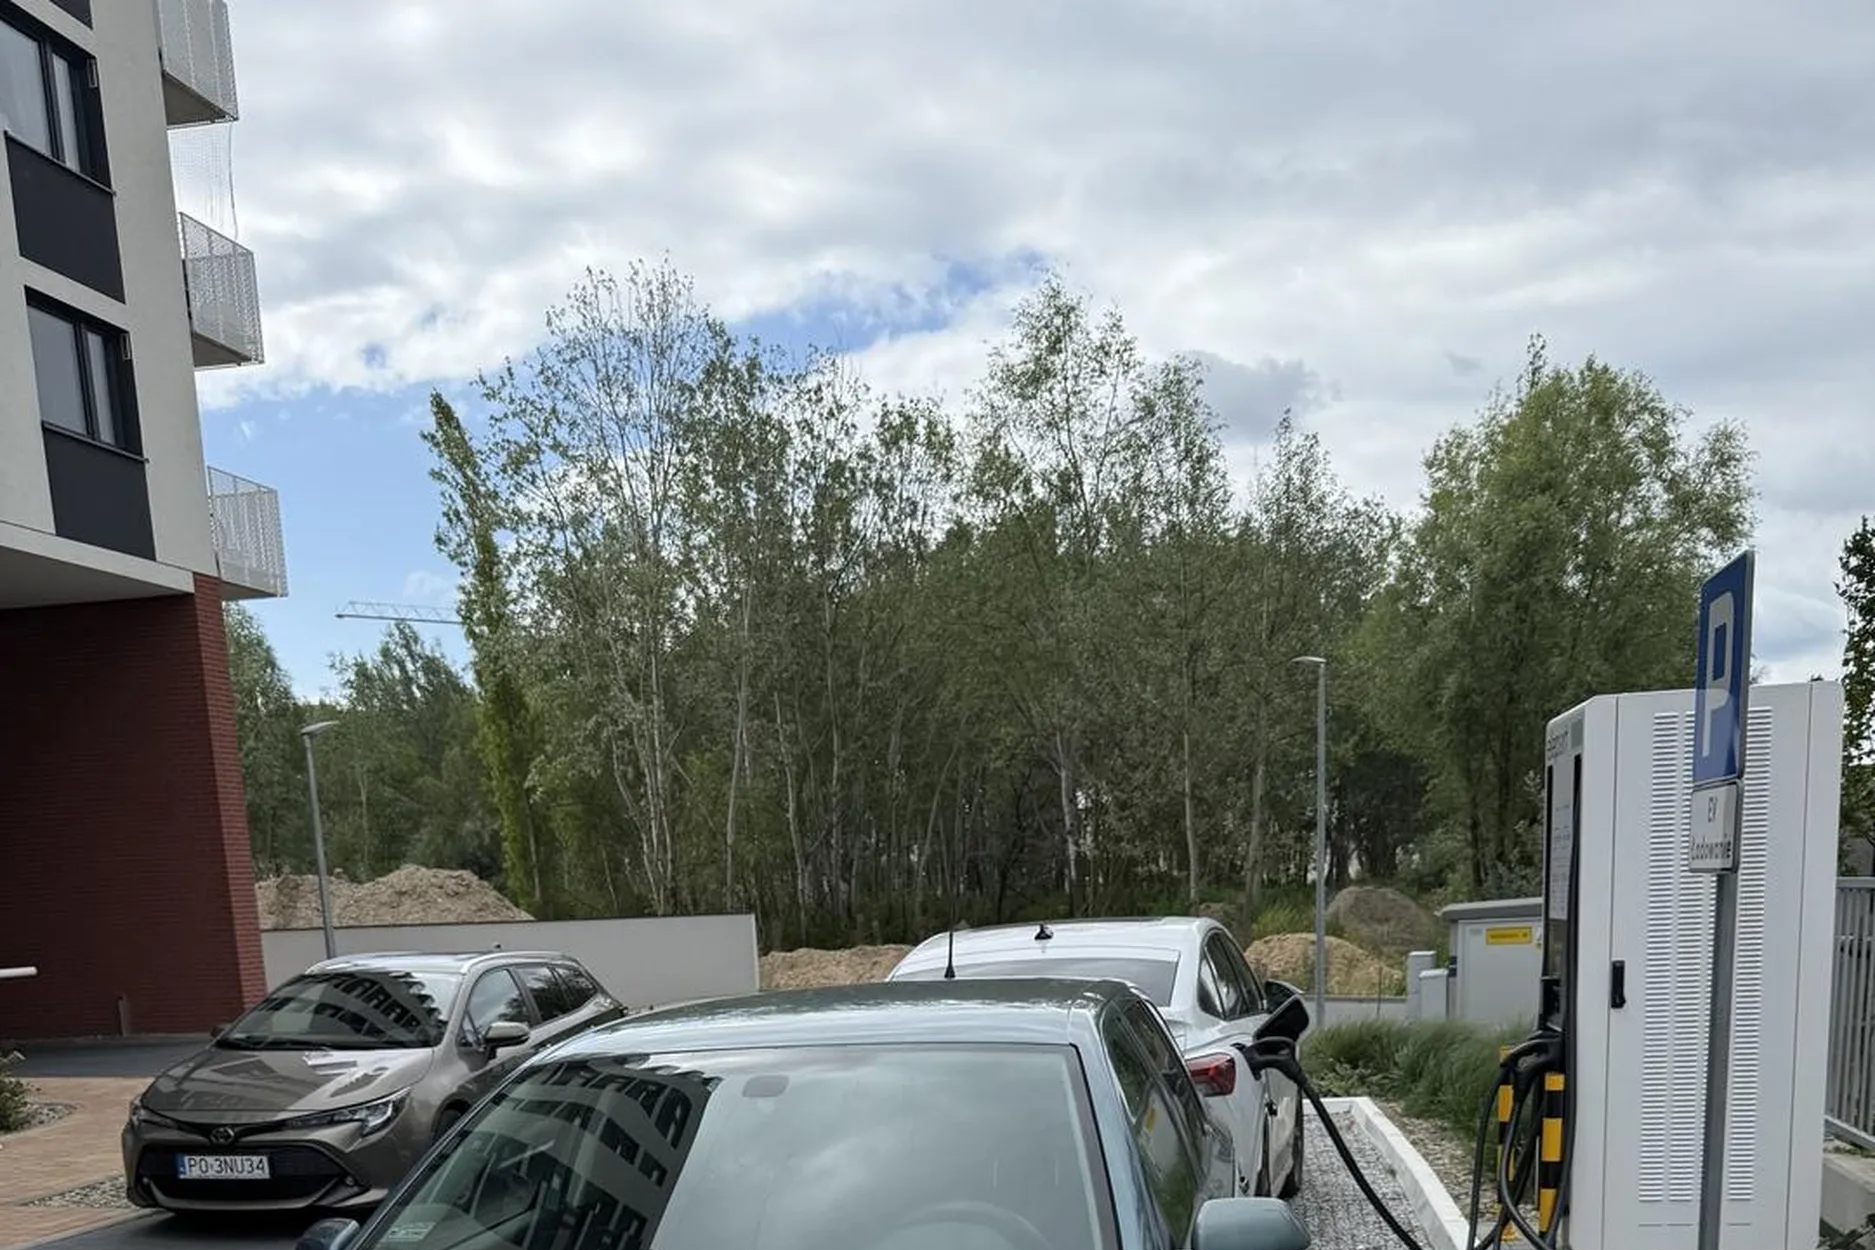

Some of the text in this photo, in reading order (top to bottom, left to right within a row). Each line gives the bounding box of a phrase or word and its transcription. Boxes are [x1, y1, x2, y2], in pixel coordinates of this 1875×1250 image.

[1704, 593, 1734, 758] P
[1708, 796, 1718, 823] EV
[188, 1158, 209, 1174] PO
[213, 1157, 265, 1174] 3NU34
